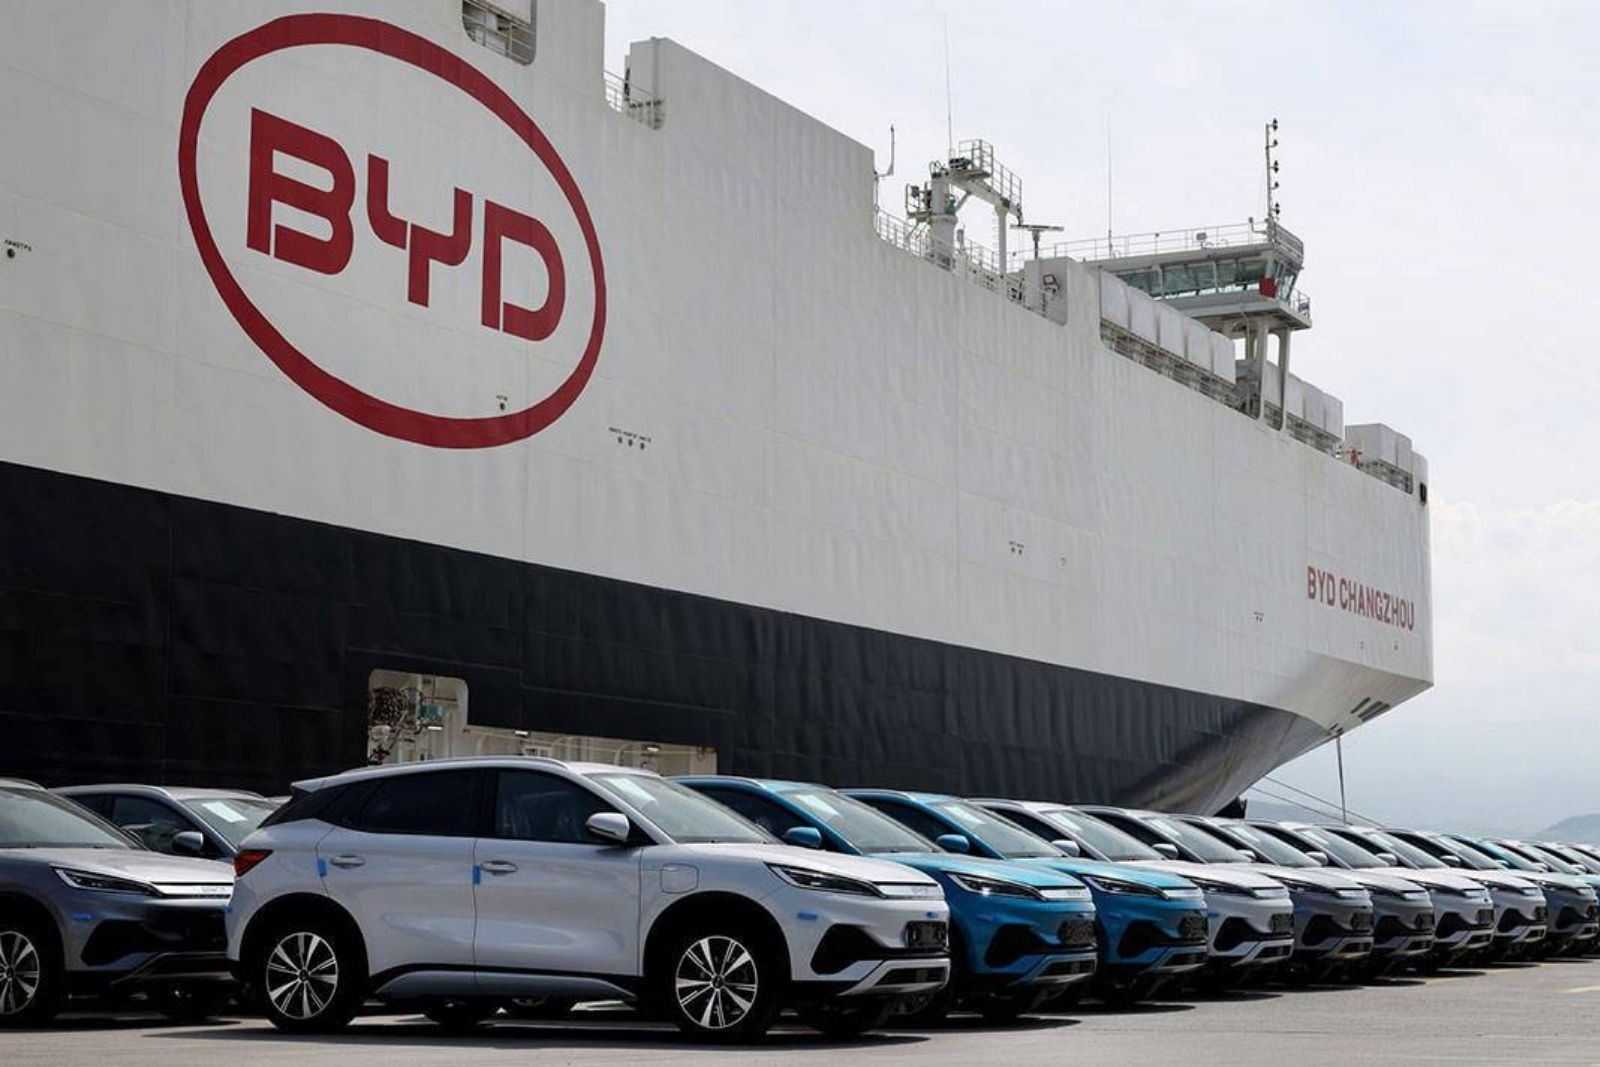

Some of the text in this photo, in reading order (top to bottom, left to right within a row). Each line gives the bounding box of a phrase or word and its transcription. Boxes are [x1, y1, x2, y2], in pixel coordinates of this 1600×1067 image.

[247, 108, 565, 342] BYD
[1307, 566, 1415, 631] BYD CHANGZHOU
